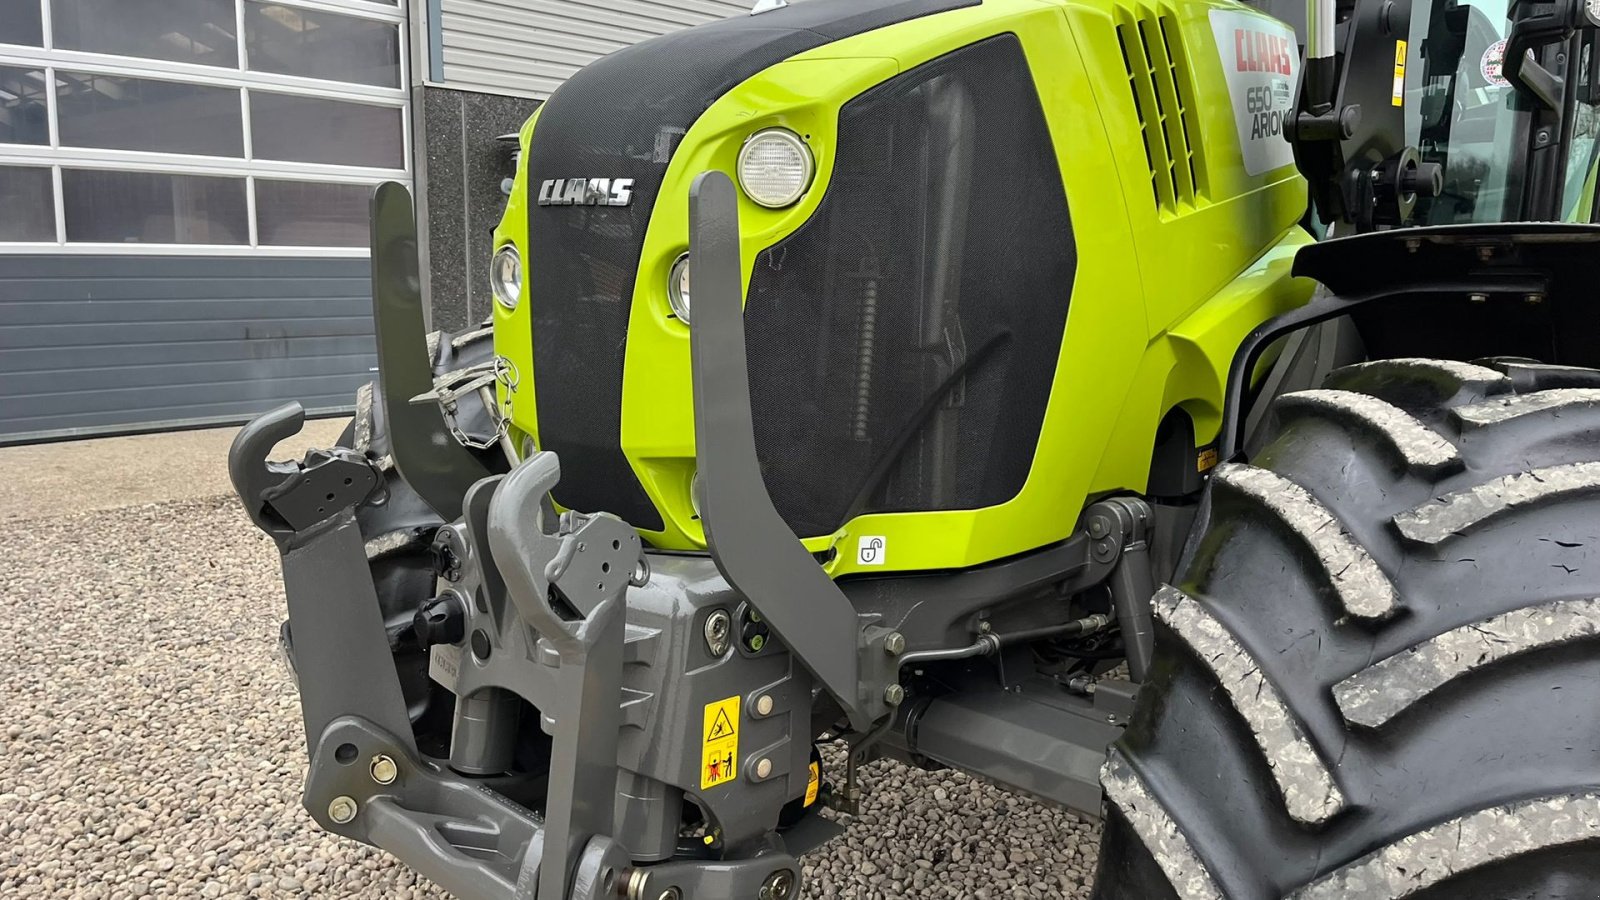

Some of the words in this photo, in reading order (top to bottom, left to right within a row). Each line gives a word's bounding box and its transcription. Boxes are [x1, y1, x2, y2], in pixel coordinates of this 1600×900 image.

[1234, 29, 1291, 75] CLAAS
[1247, 86, 1272, 113] 650
[538, 178, 635, 206] CLAAS
